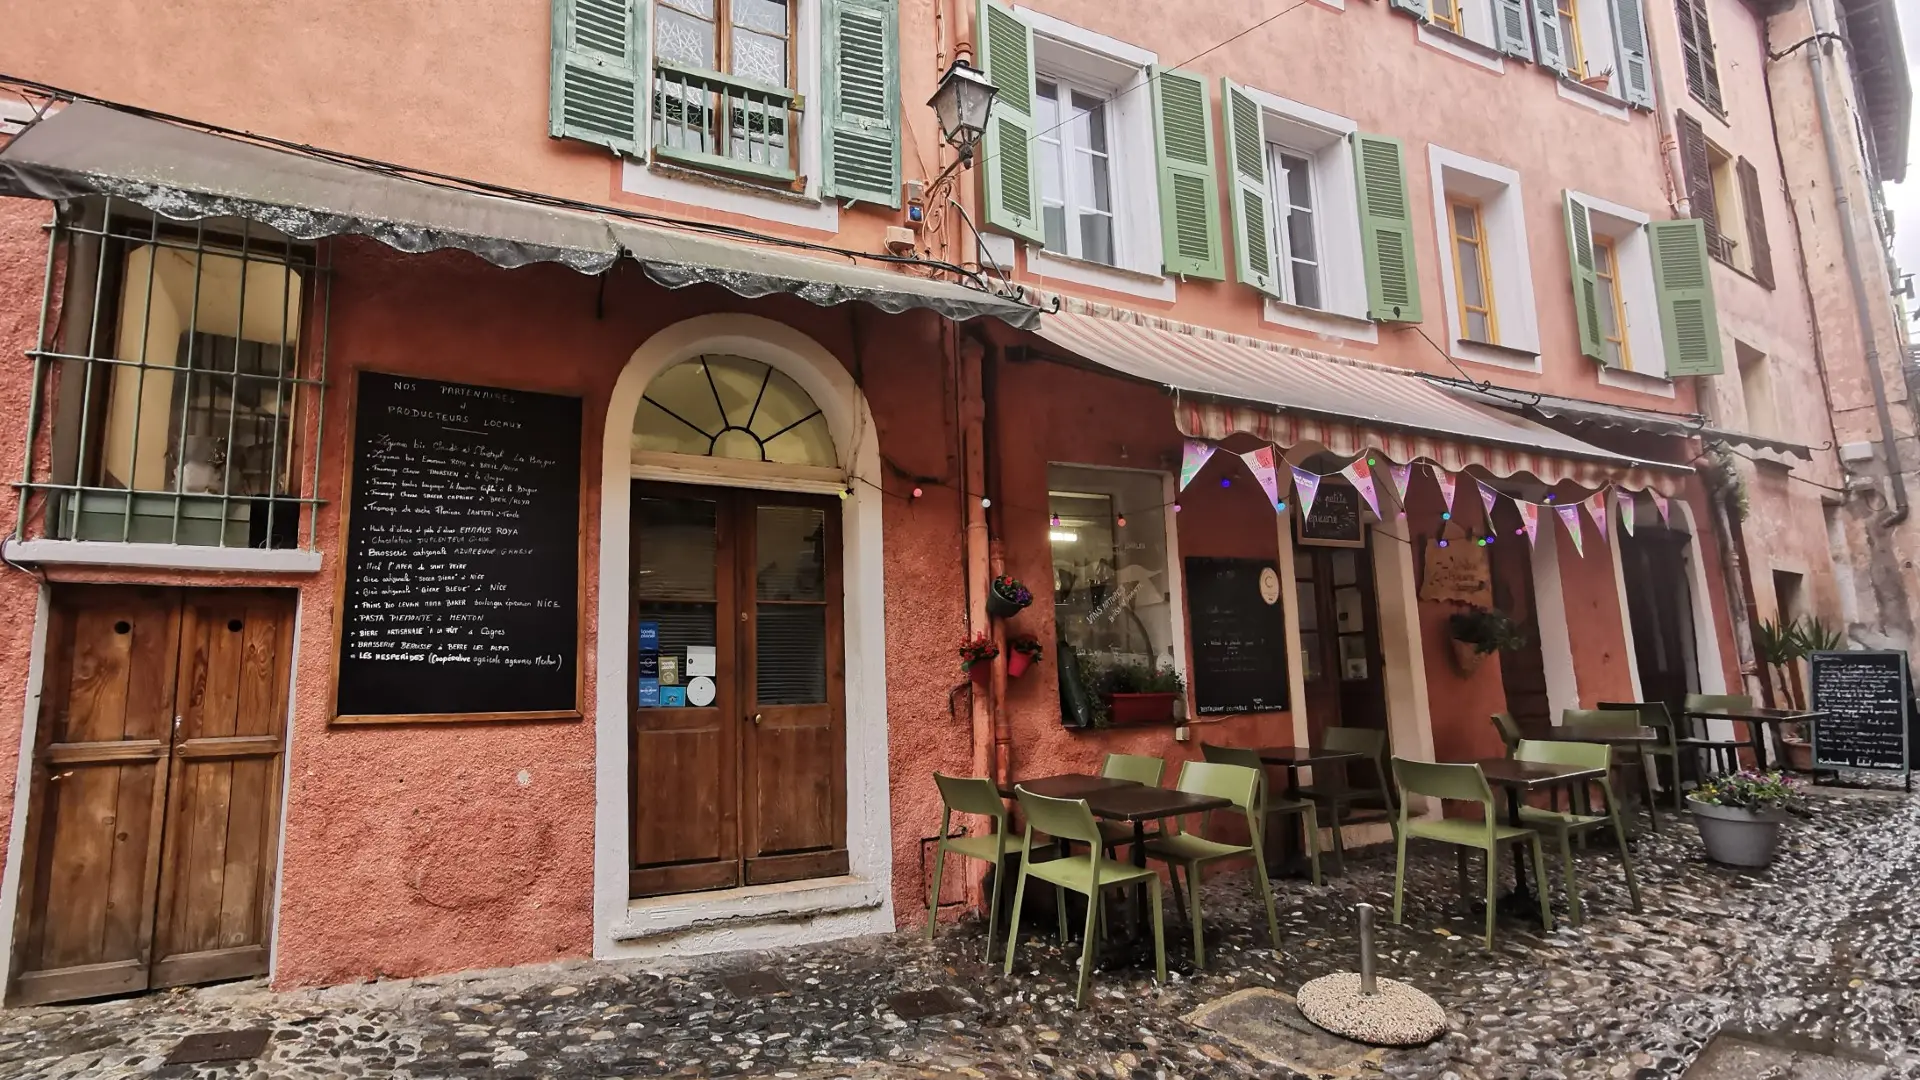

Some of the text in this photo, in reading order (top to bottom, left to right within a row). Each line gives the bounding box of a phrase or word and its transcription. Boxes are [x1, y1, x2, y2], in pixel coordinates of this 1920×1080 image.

[394, 382, 515, 403] NOS PARTENAIRES
[388, 406, 522, 429] PRODUCTEURS LOCAUX
[496, 526, 518, 536] ROYA
[536, 598, 560, 608] NICE
[360, 614, 384, 622] PASTA
[389, 614, 433, 622] PIEMONTE
[480, 626, 505, 640] Cagnes
[359, 652, 372, 660] LES
